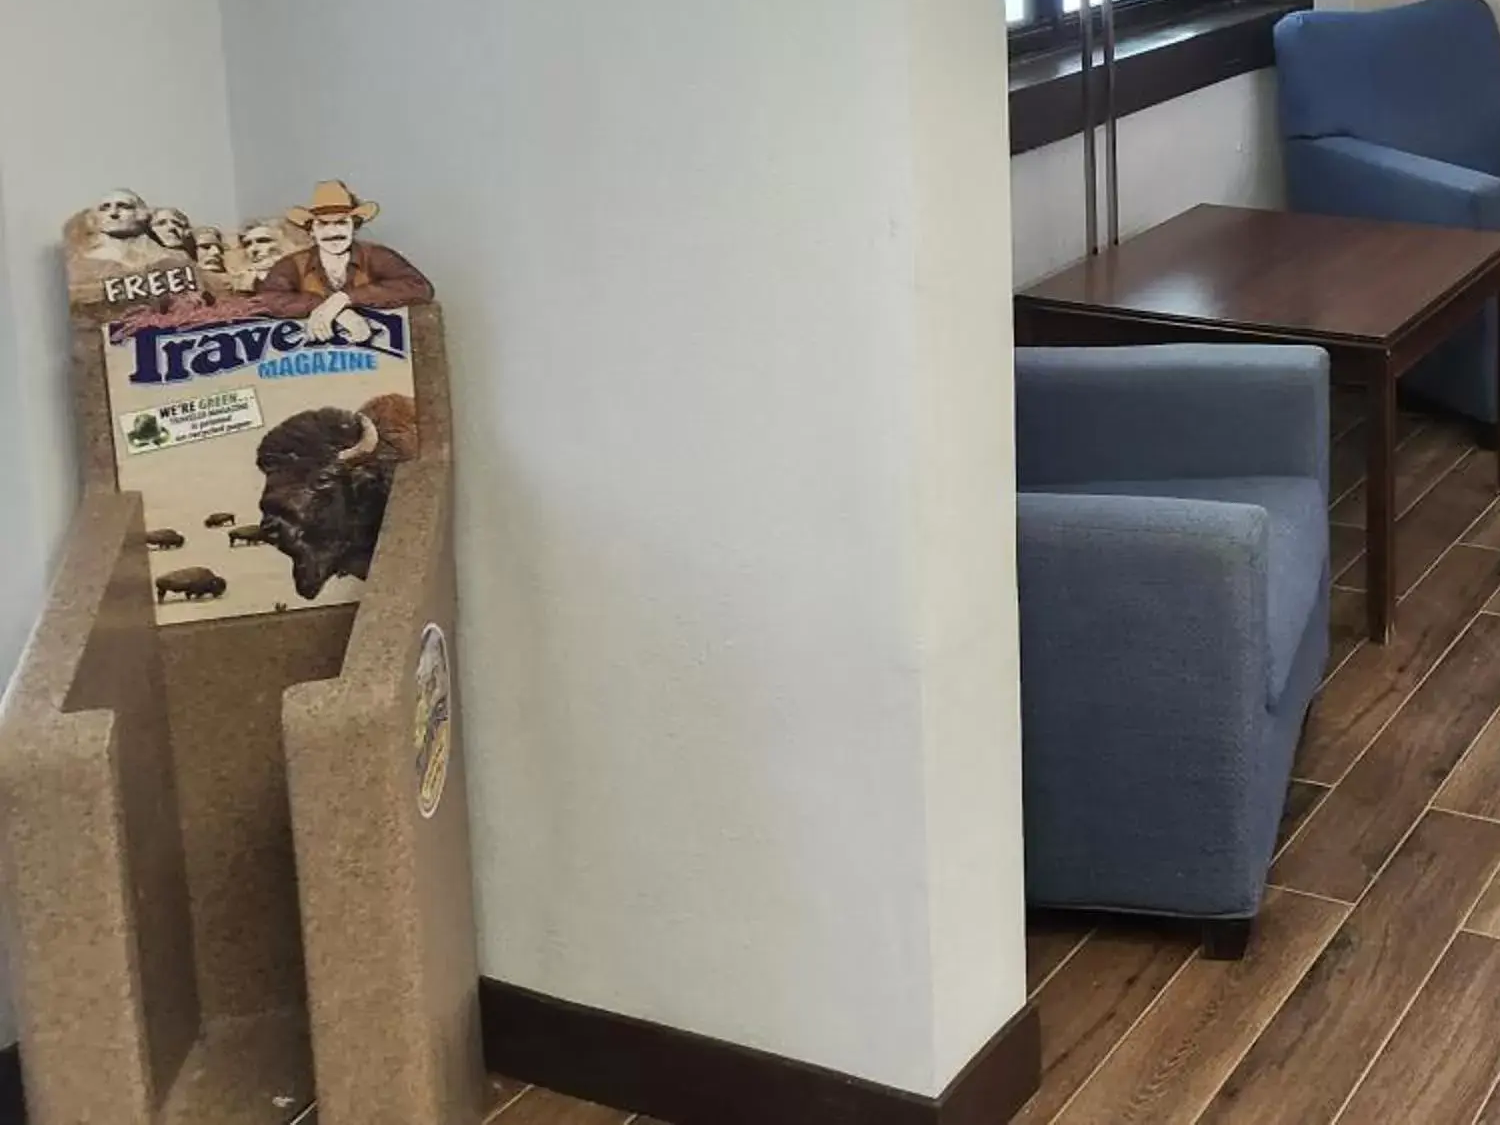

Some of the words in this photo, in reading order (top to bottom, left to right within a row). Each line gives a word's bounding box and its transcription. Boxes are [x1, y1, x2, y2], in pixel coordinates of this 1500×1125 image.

[104, 266, 198, 303] FREE!
[109, 306, 406, 383] Trave
[257, 349, 378, 380] MAGAZINE
[159, 401, 195, 417] WE'RE
